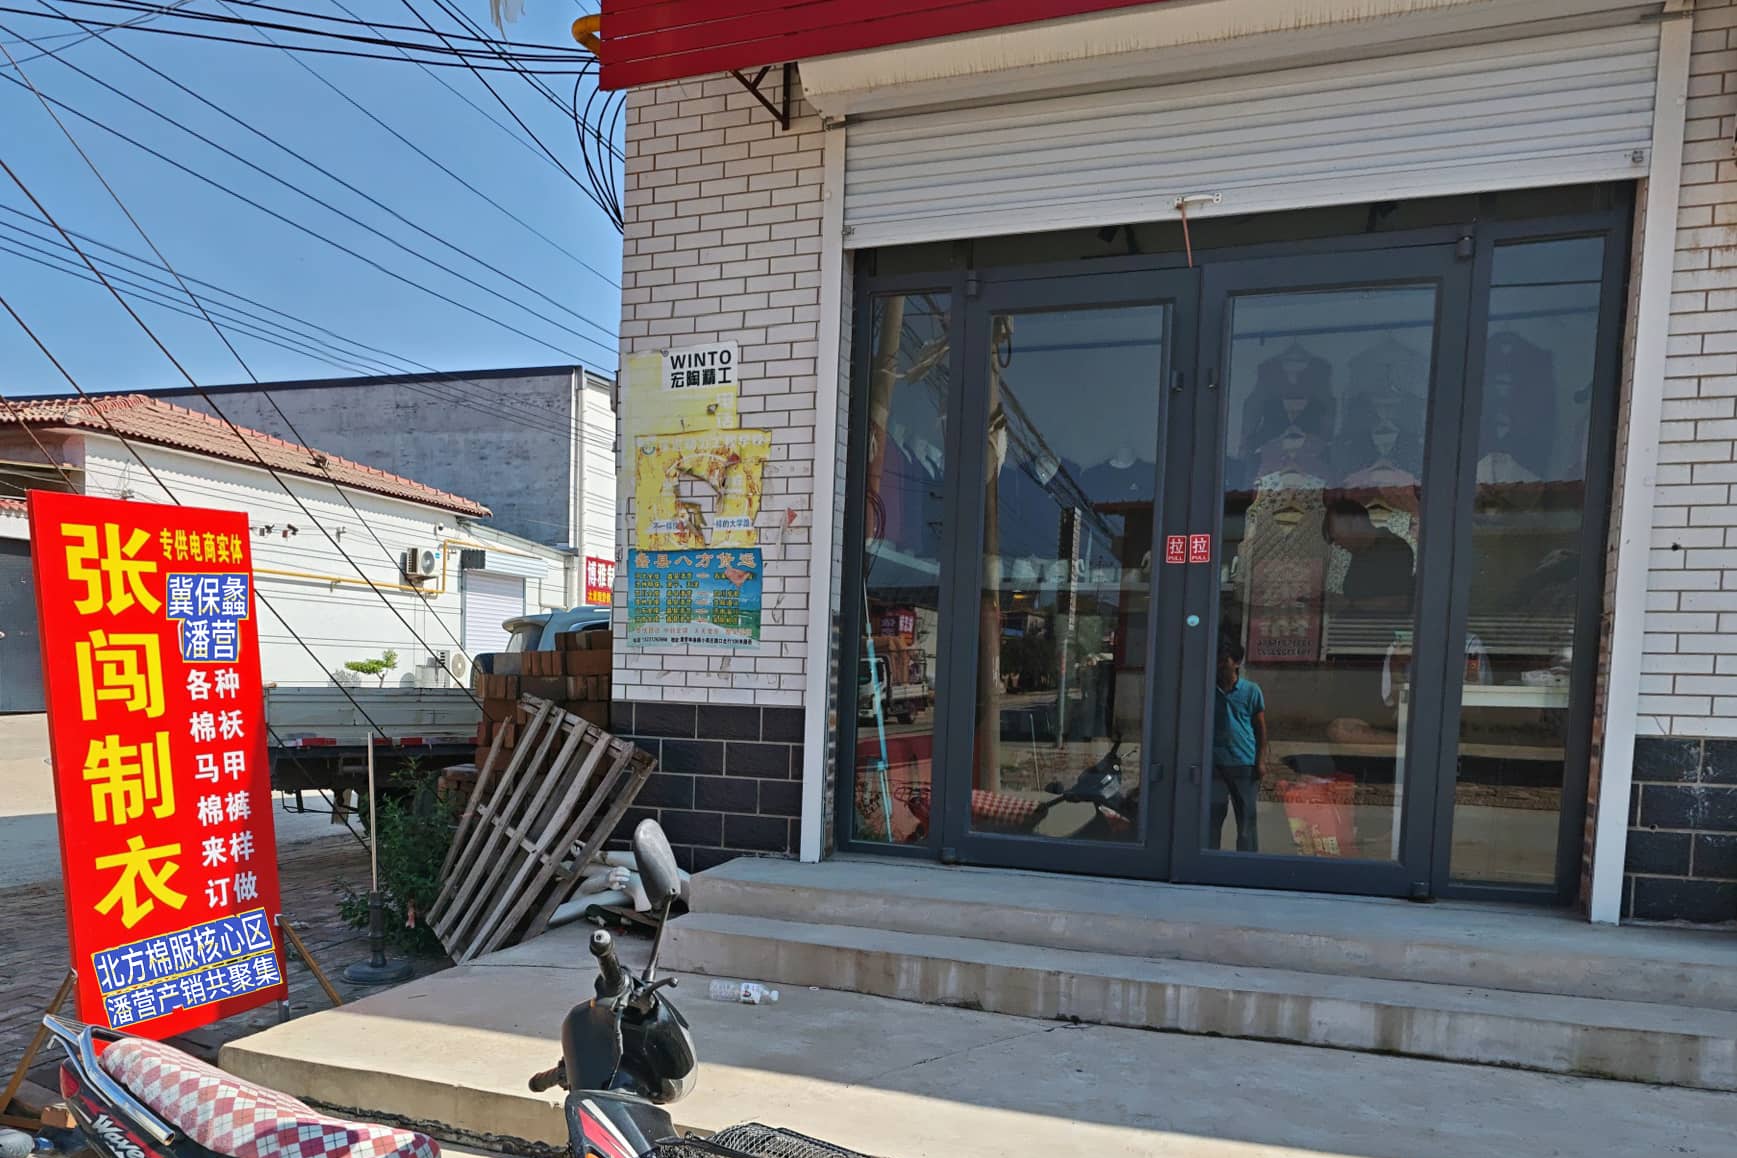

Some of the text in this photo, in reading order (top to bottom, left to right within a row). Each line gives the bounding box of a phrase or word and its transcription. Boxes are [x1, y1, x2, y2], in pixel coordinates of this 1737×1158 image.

[670, 350, 732, 370] WINTO
[671, 367, 732, 389] 宏陶精工
[159, 528, 243, 564] 专供电商实体
[1169, 538, 1184, 554] 拉
[1192, 537, 1207, 554] 拉
[186, 667, 240, 701] 各种
[60, 522, 188, 930] 张闯制衣
[189, 709, 245, 743] 棉袄
[194, 750, 246, 783] 马甲
[197, 790, 251, 827] 棉裤
[201, 830, 255, 868] 来样
[205, 870, 258, 909] 订做
